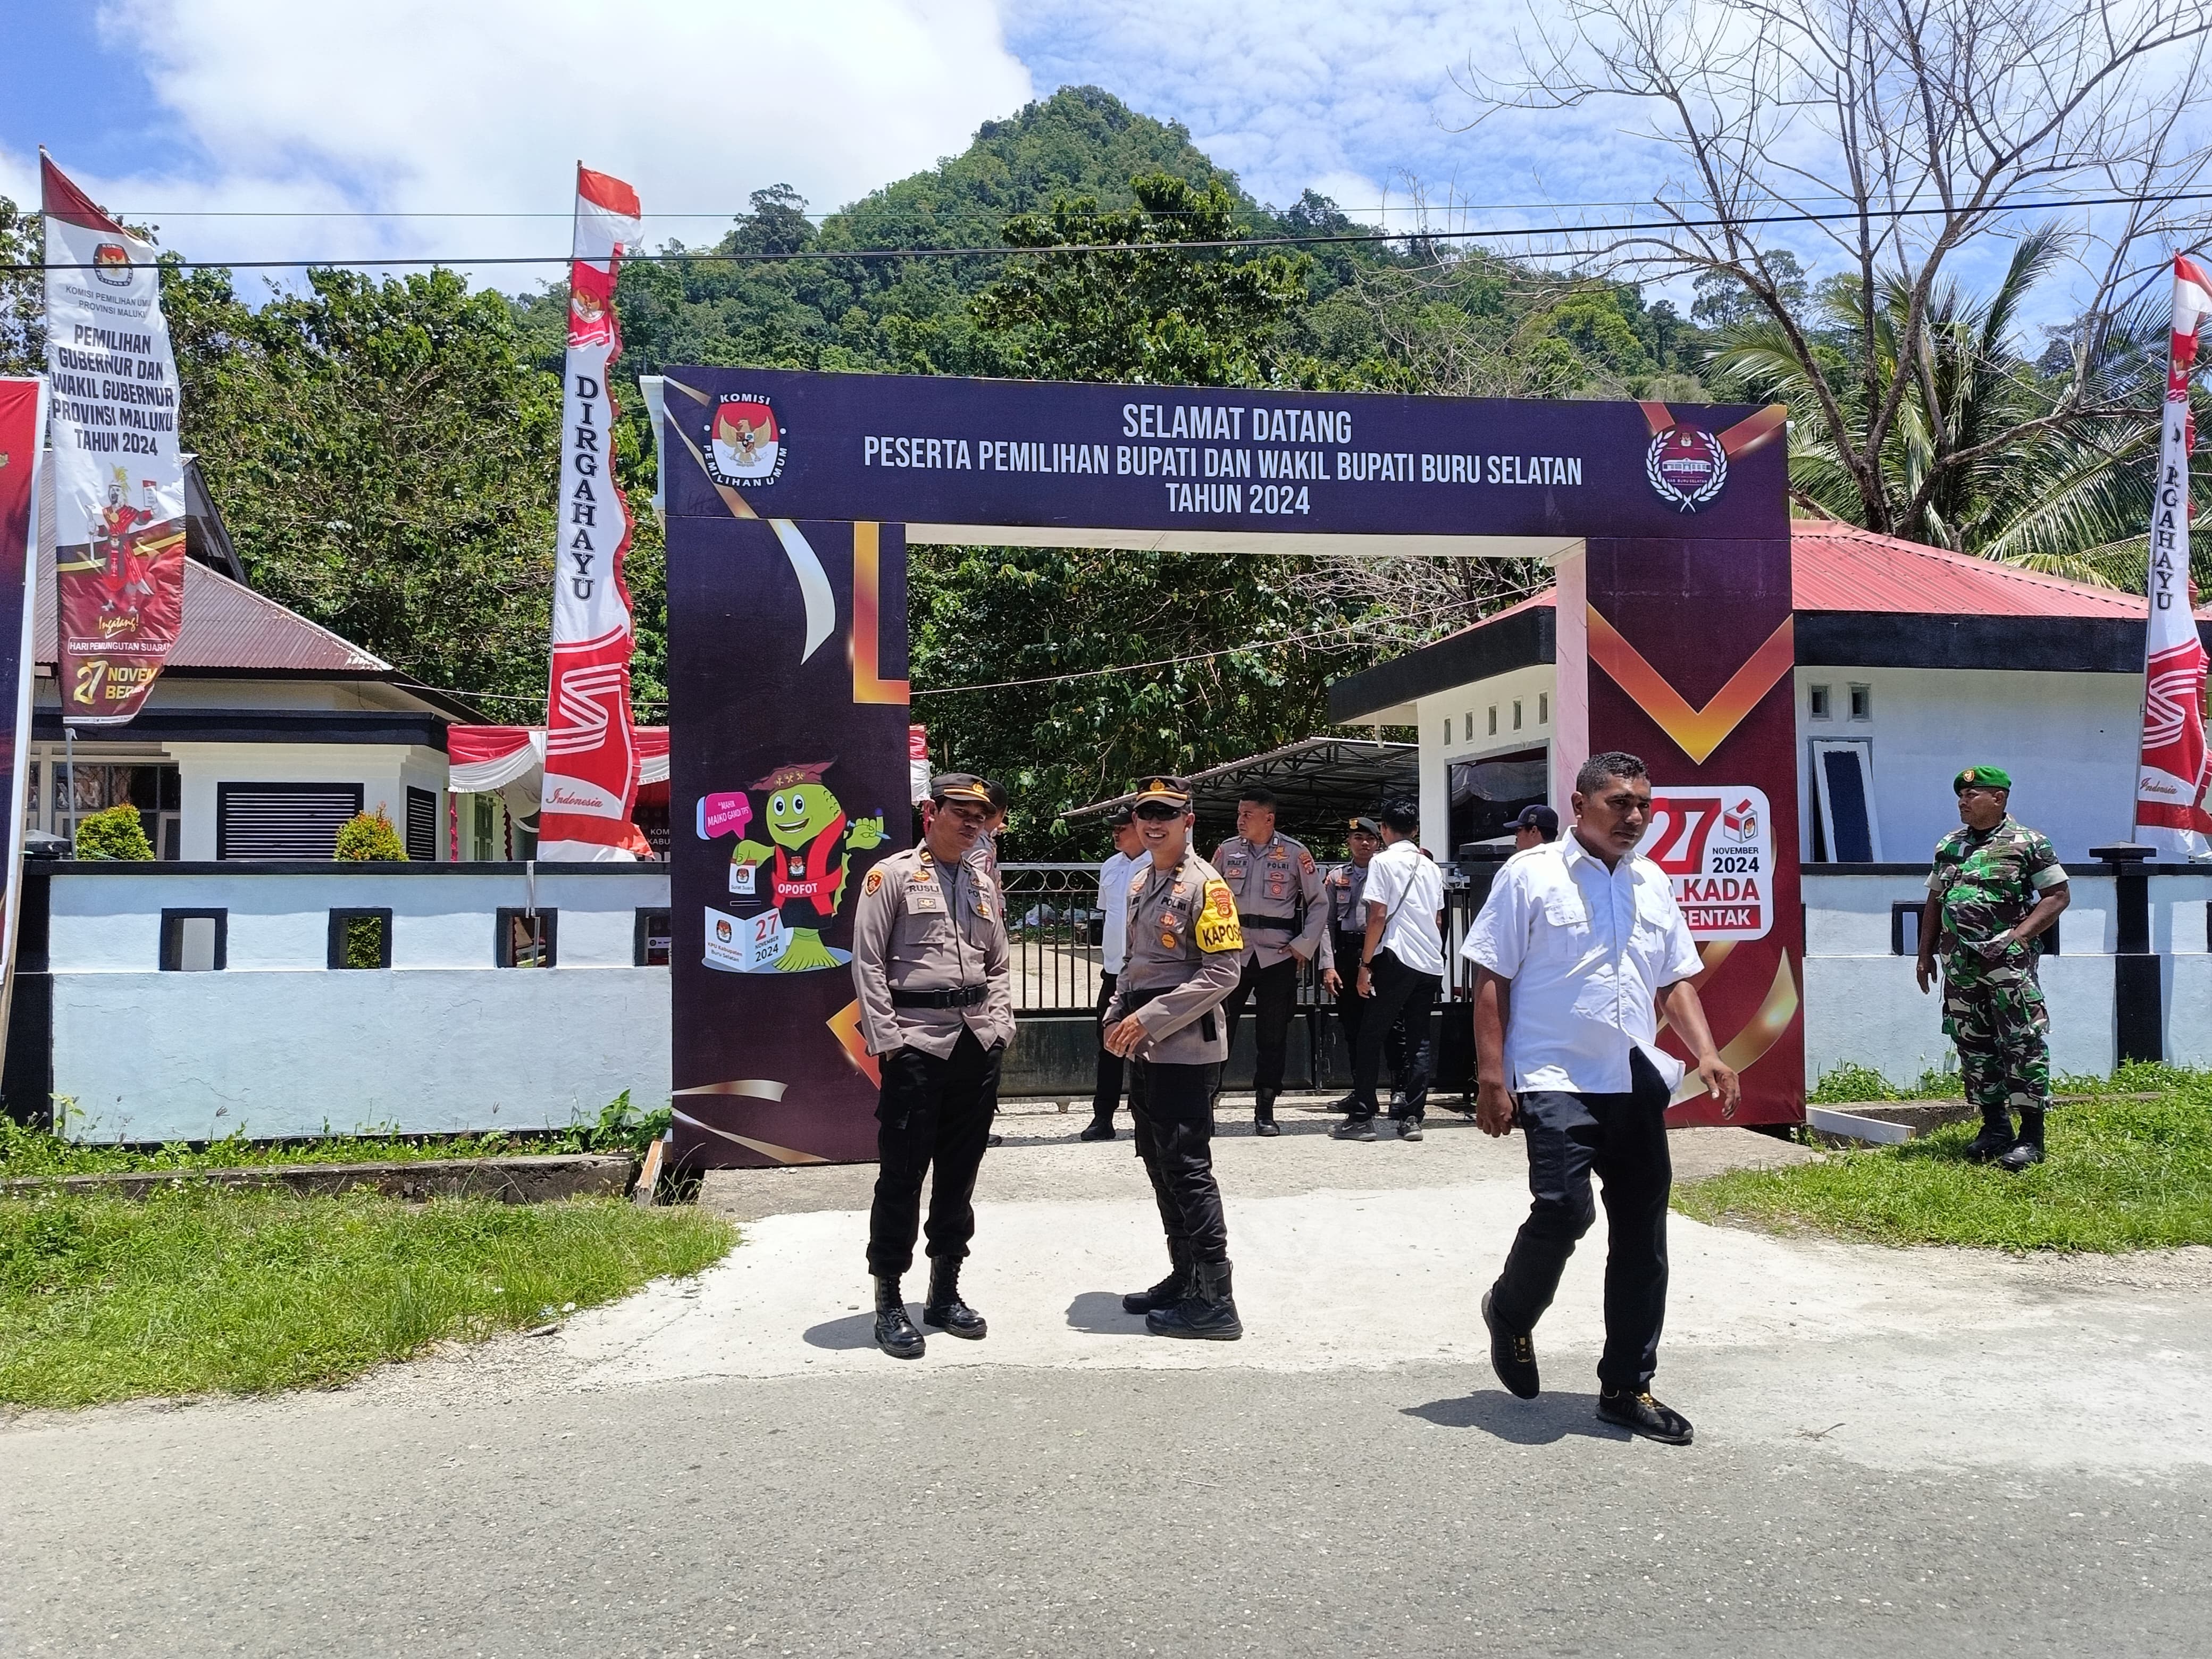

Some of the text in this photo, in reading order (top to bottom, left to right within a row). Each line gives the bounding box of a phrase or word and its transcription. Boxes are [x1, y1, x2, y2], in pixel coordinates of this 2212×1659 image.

[65, 285, 94, 298] KOMISI
[95, 292, 136, 306] PEMILIHAN
[79, 300, 115, 315] PROVINSI
[74, 324, 151, 355] PEMILIHAN
[58, 347, 163, 381] GUBERNUR DAN
[52, 372, 174, 407] WAKIL GUBERNUR
[720, 393, 771, 405] KOMISI
[52, 399, 173, 432] PROVINSI MALUKU
[1122, 403, 1352, 445] SELAMAT DATANG
[74, 429, 158, 456] TAHUN 2024
[703, 445, 787, 487] PEMILIHAN UMUM
[864, 435, 1582, 485] PESERTA PEMILIHAN BUPATI DAN WAKIL BUPATI BURU SELATAN
[570, 374, 600, 601] DIRGAHAYU
[1165, 483, 1310, 515] TAHUN 2024
[2156, 422, 2181, 611] RGAHAYU
[98, 614, 139, 633] Ingatang!
[70, 642, 89, 650] HARI
[89, 642, 139, 651] PEMUNGUTAN
[73, 660, 109, 705] 27
[546, 787, 603, 808] Indonesia
[707, 812, 727, 827] MAIKO
[1646, 798, 1722, 874] 27
[1712, 857, 1759, 873] 2024
[778, 883, 818, 894] OPOFOT
[968, 889, 991, 904] PORI
[1671, 878, 1761, 902] KADA
[1161, 896, 1186, 911] POLRI
[755, 913, 779, 942] 27
[718, 943, 743, 957] Kabupaten
[755, 935, 779, 950] NOVEMBER
[755, 943, 779, 962] 2024
[723, 953, 740, 962] Selatan
